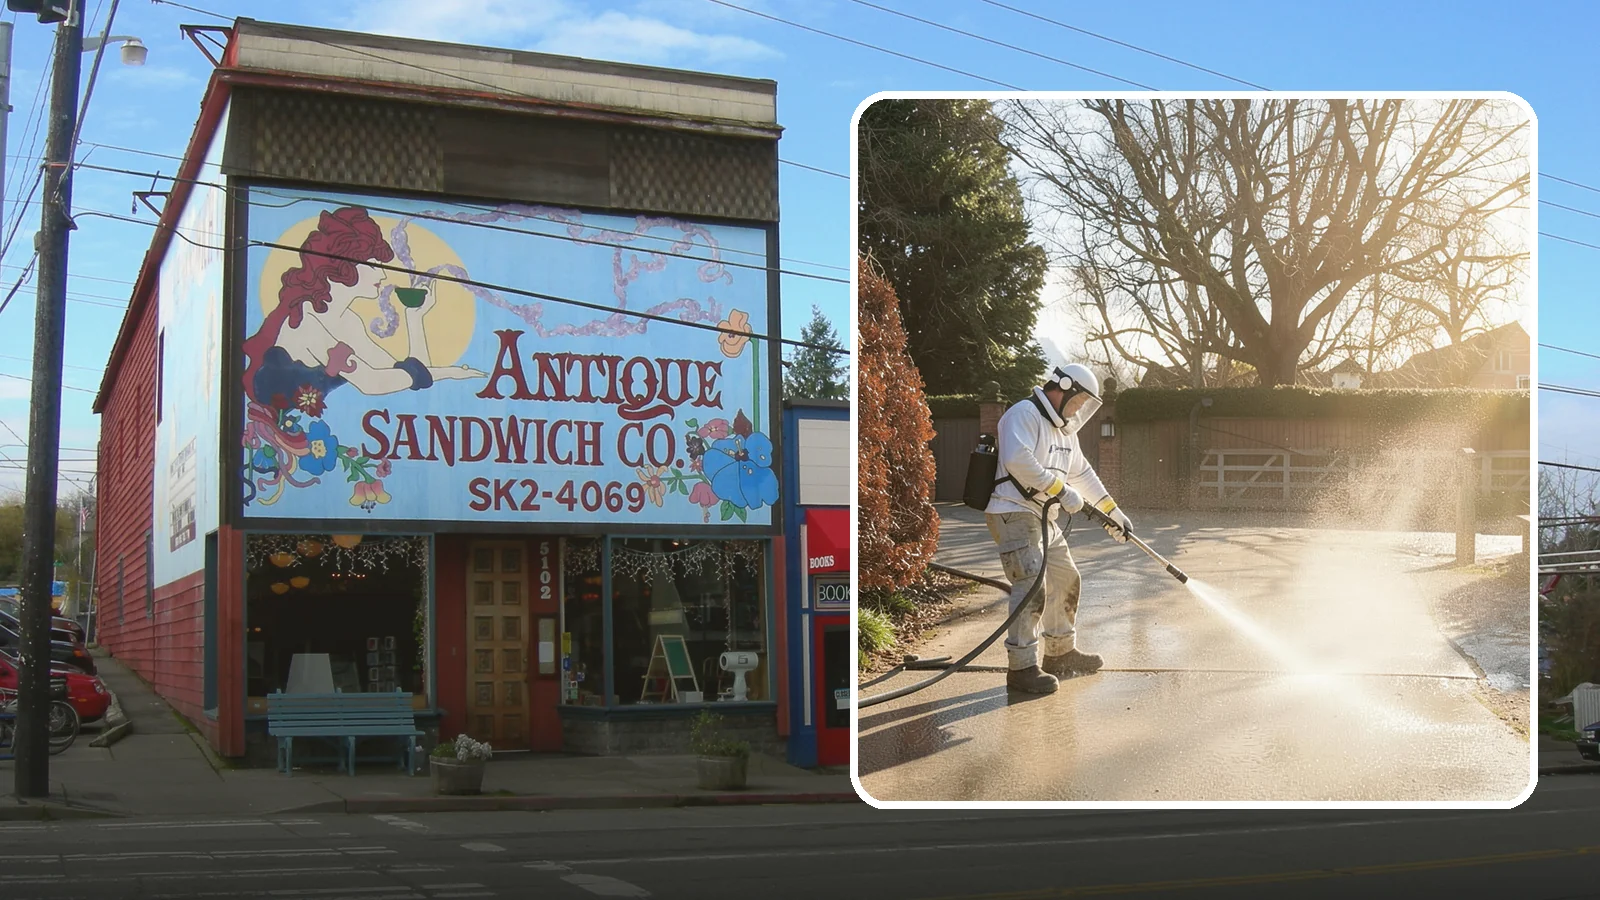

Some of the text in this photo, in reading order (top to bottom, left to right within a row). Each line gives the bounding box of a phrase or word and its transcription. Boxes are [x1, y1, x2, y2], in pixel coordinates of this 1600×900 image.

[476, 329, 723, 421] ANTIQUE
[361, 408, 684, 469] SANDWICH CO.
[468, 477, 645, 512] SK2-4069
[540, 541, 552, 600] 5102
[809, 555, 835, 569] BOOKS
